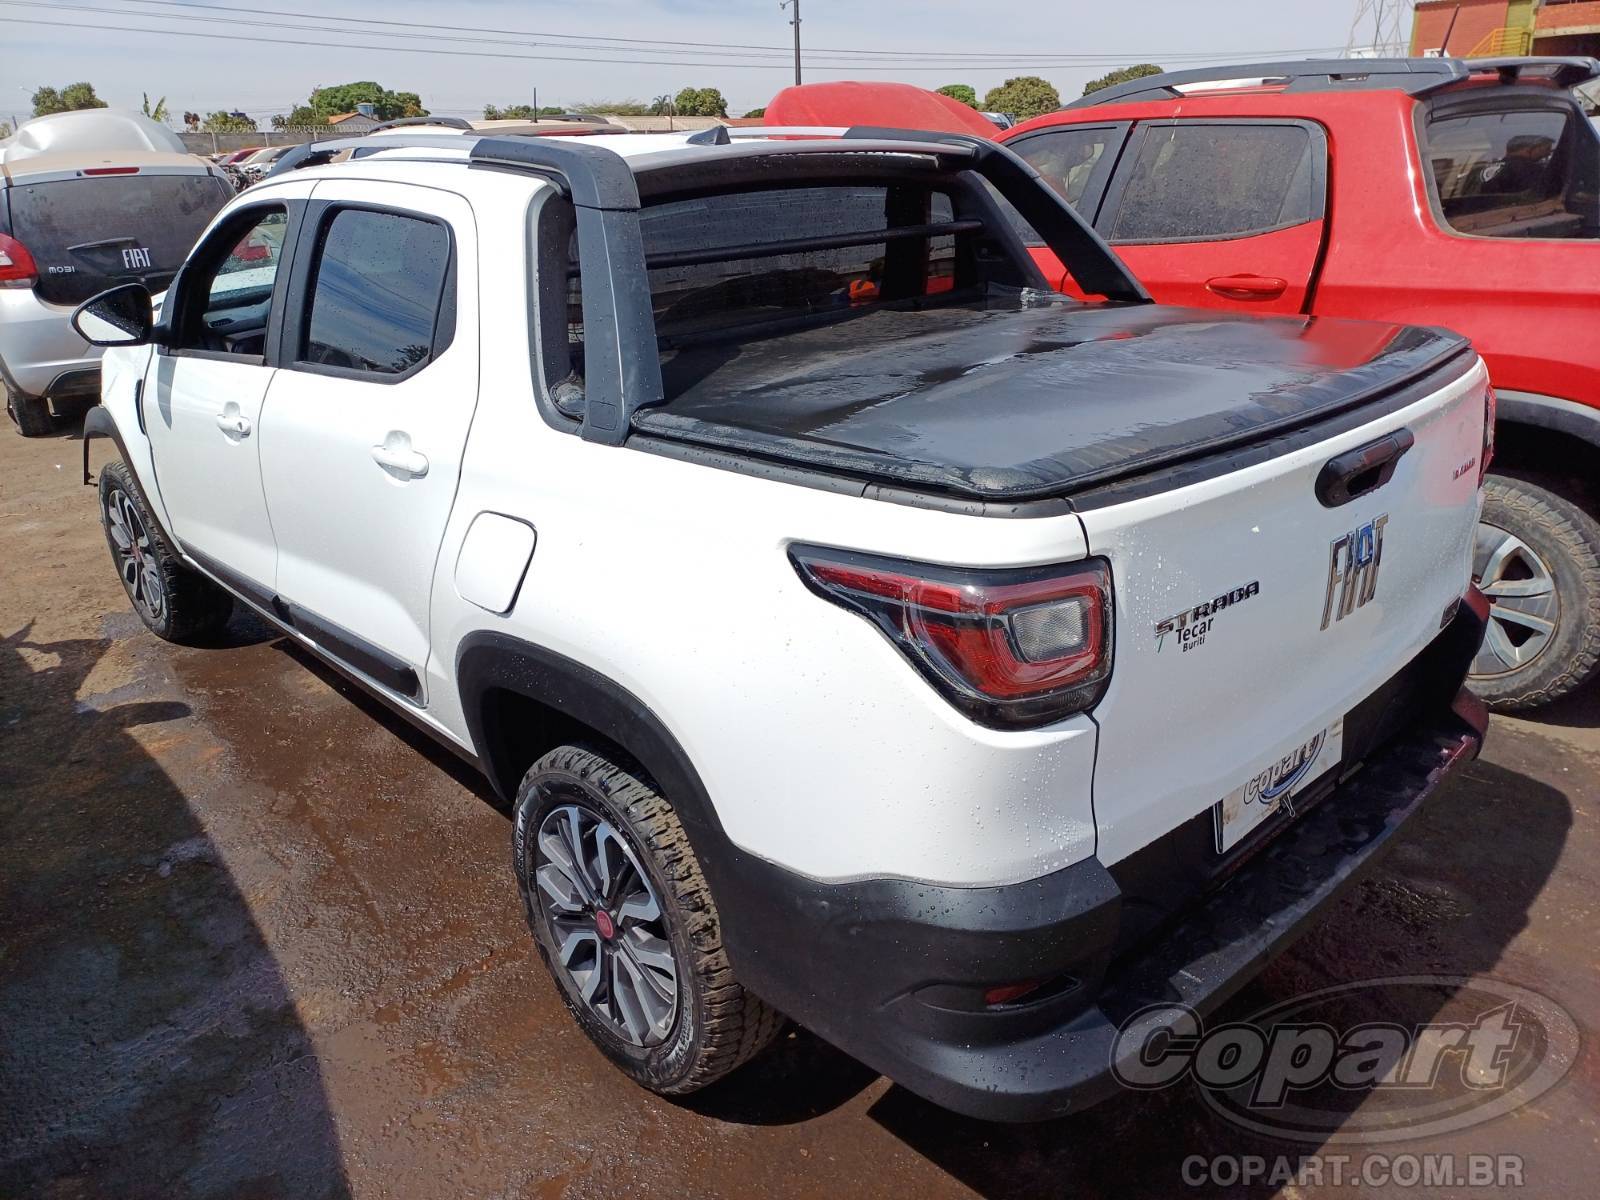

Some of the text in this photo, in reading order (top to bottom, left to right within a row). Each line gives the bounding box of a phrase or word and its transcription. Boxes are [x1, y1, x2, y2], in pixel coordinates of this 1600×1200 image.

[121, 247, 151, 269] FIAT
[1319, 512, 1389, 631] FIAT
[1155, 580, 1260, 638] STRADA
[1175, 617, 1214, 644] Tecar
[1182, 635, 1206, 653] Buriti
[1243, 733, 1320, 805] Copart
